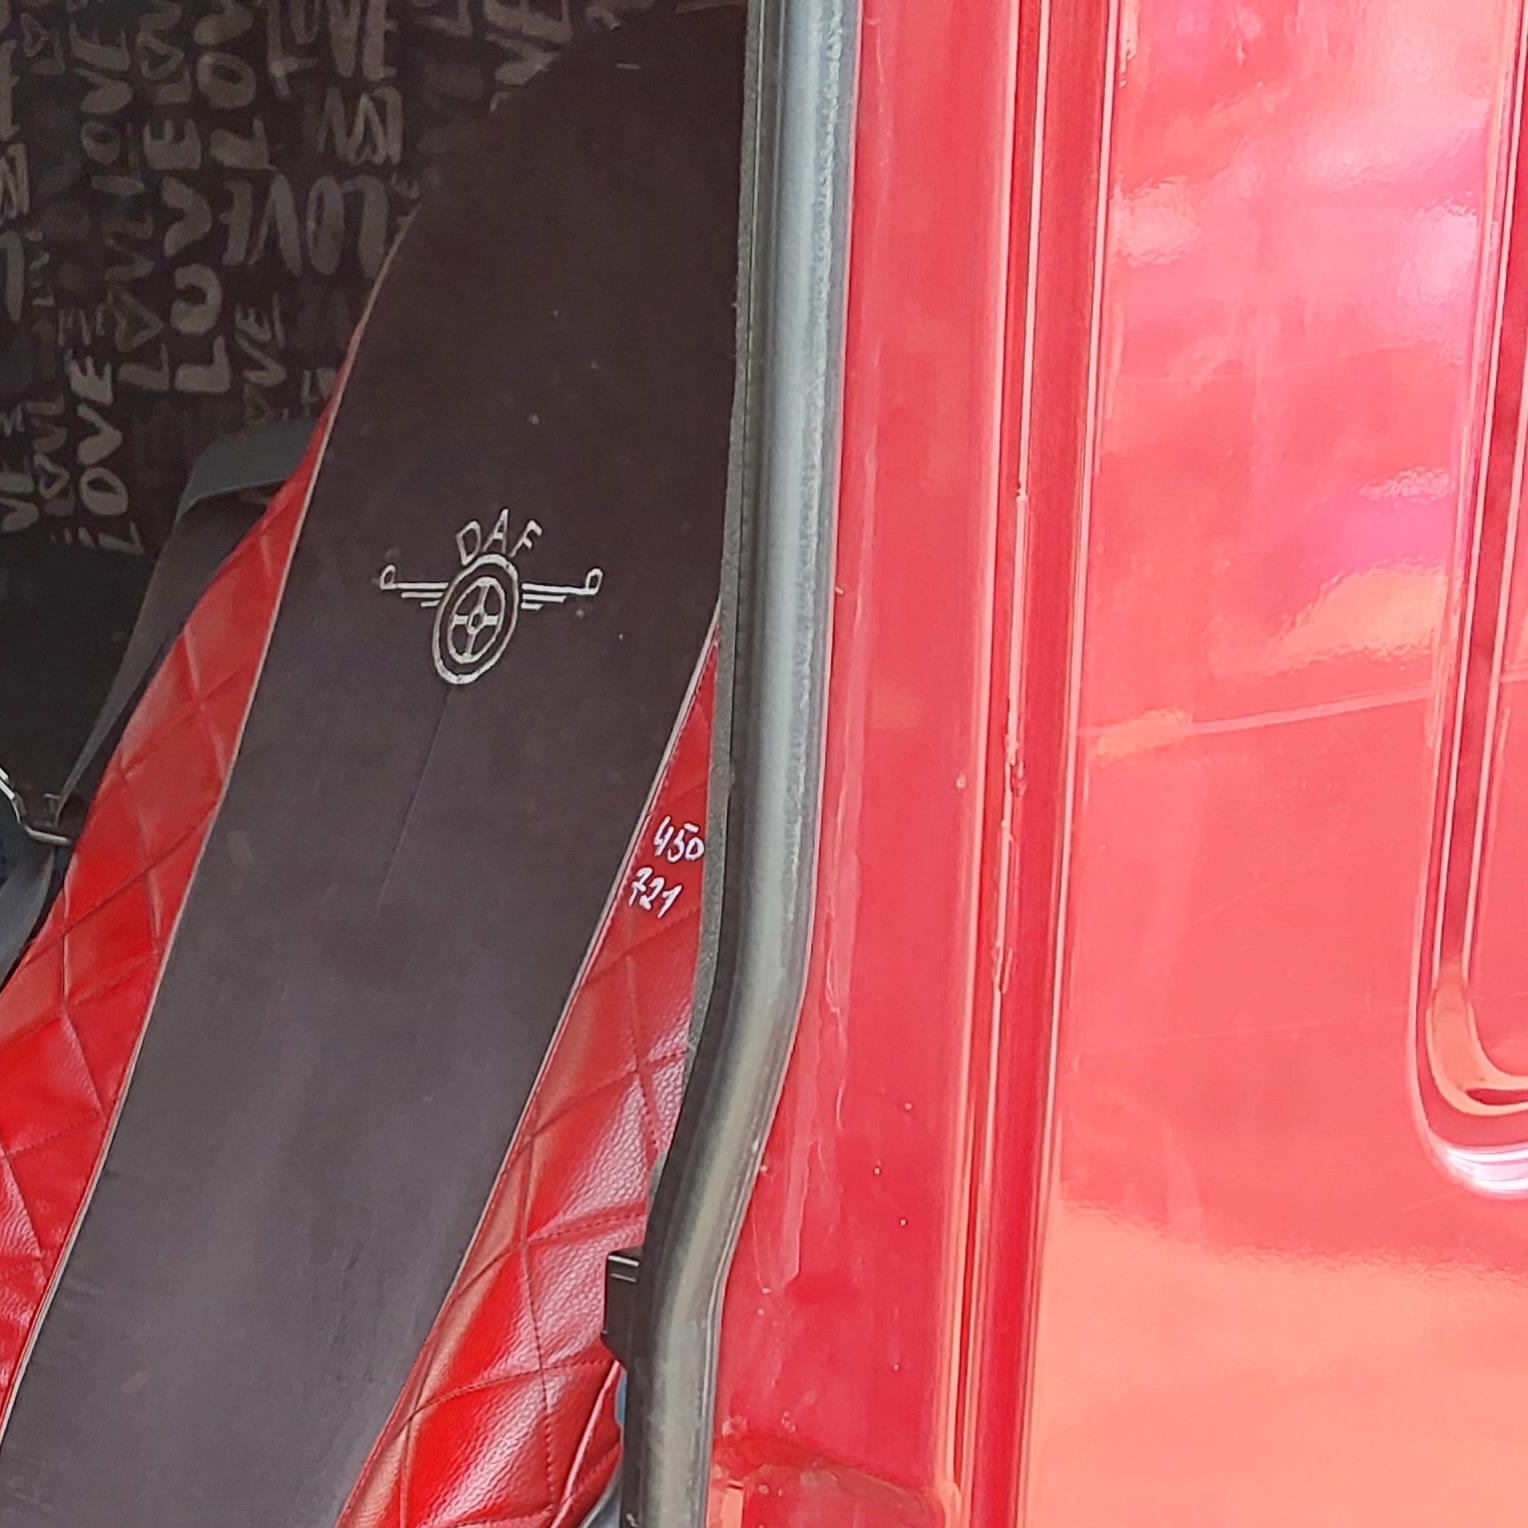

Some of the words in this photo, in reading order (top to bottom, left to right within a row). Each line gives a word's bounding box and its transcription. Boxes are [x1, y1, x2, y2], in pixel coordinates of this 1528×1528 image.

[142, 118, 231, 393] LOVE
[456, 508, 542, 566] DAF
[654, 817, 704, 863] 450
